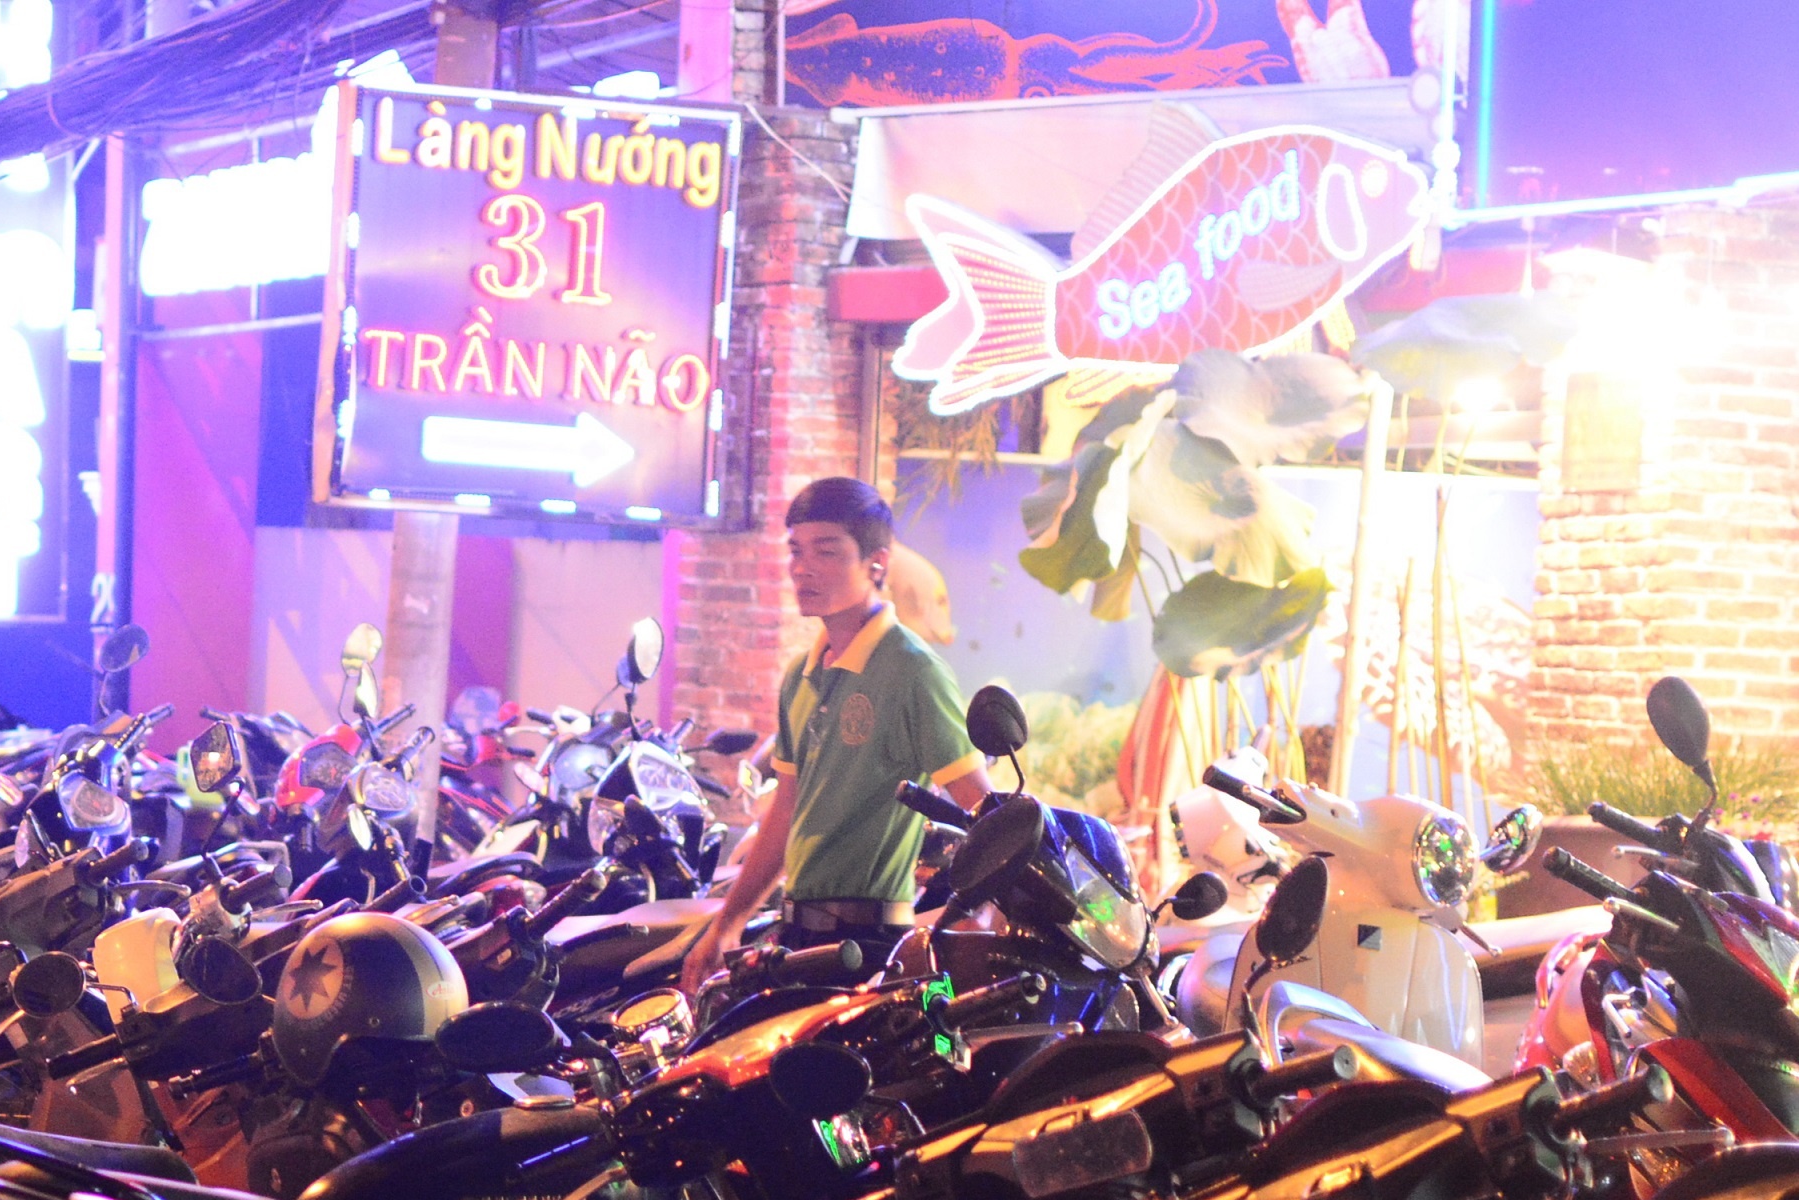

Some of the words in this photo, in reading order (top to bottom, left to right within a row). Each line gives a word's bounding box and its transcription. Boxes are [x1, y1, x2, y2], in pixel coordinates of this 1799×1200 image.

[375, 97, 526, 189] Làng
[535, 113, 721, 208] Nướng
[473, 194, 612, 305] 31
[1098, 261, 1192, 339] Sea
[1194, 149, 1300, 281] food
[363, 306, 546, 398] TRẦN
[570, 328, 711, 412] NÃO
